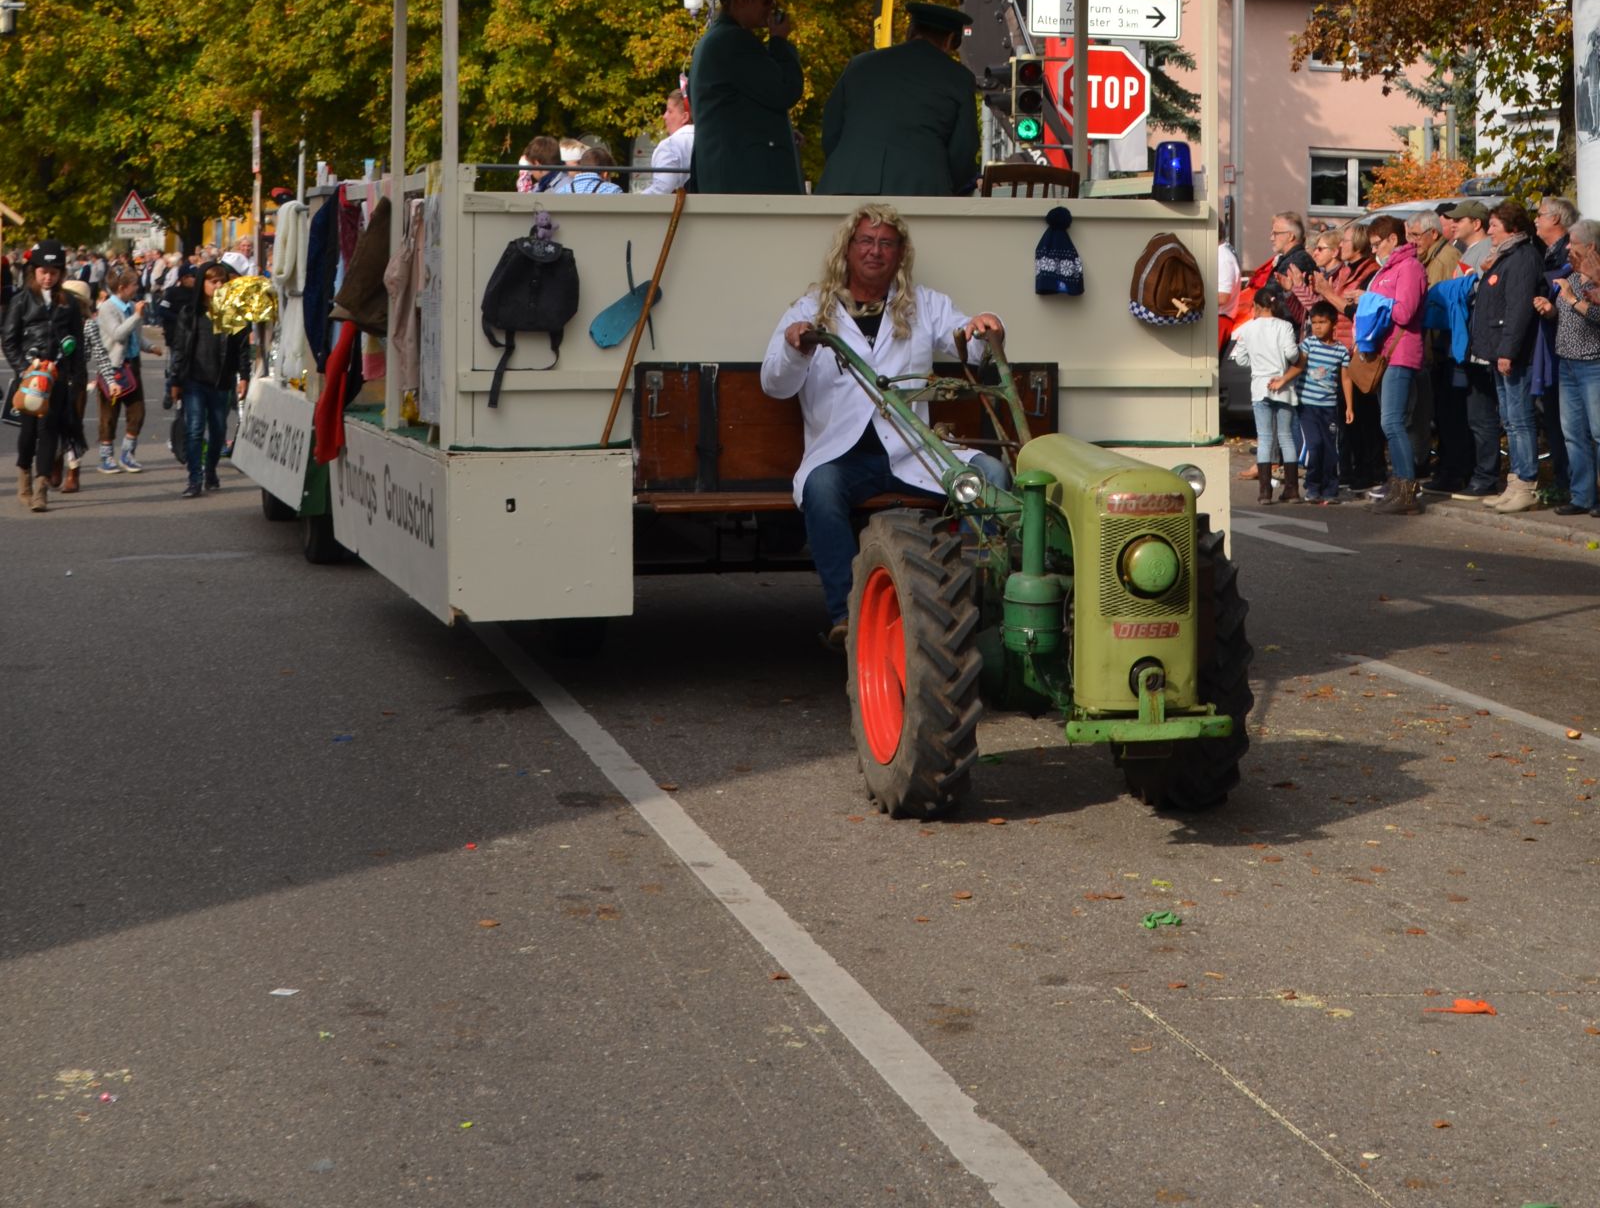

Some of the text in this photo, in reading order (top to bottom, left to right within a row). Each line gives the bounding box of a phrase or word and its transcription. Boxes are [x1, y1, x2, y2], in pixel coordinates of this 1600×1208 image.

[1066, 2, 1139, 15] Zrum 6 km
[1037, 15, 1139, 29] Altenmster 3 km
[1070, 75, 1140, 110] TOP
[384, 463, 436, 548] Gruuschd
[1119, 622, 1176, 638] DIESEL
